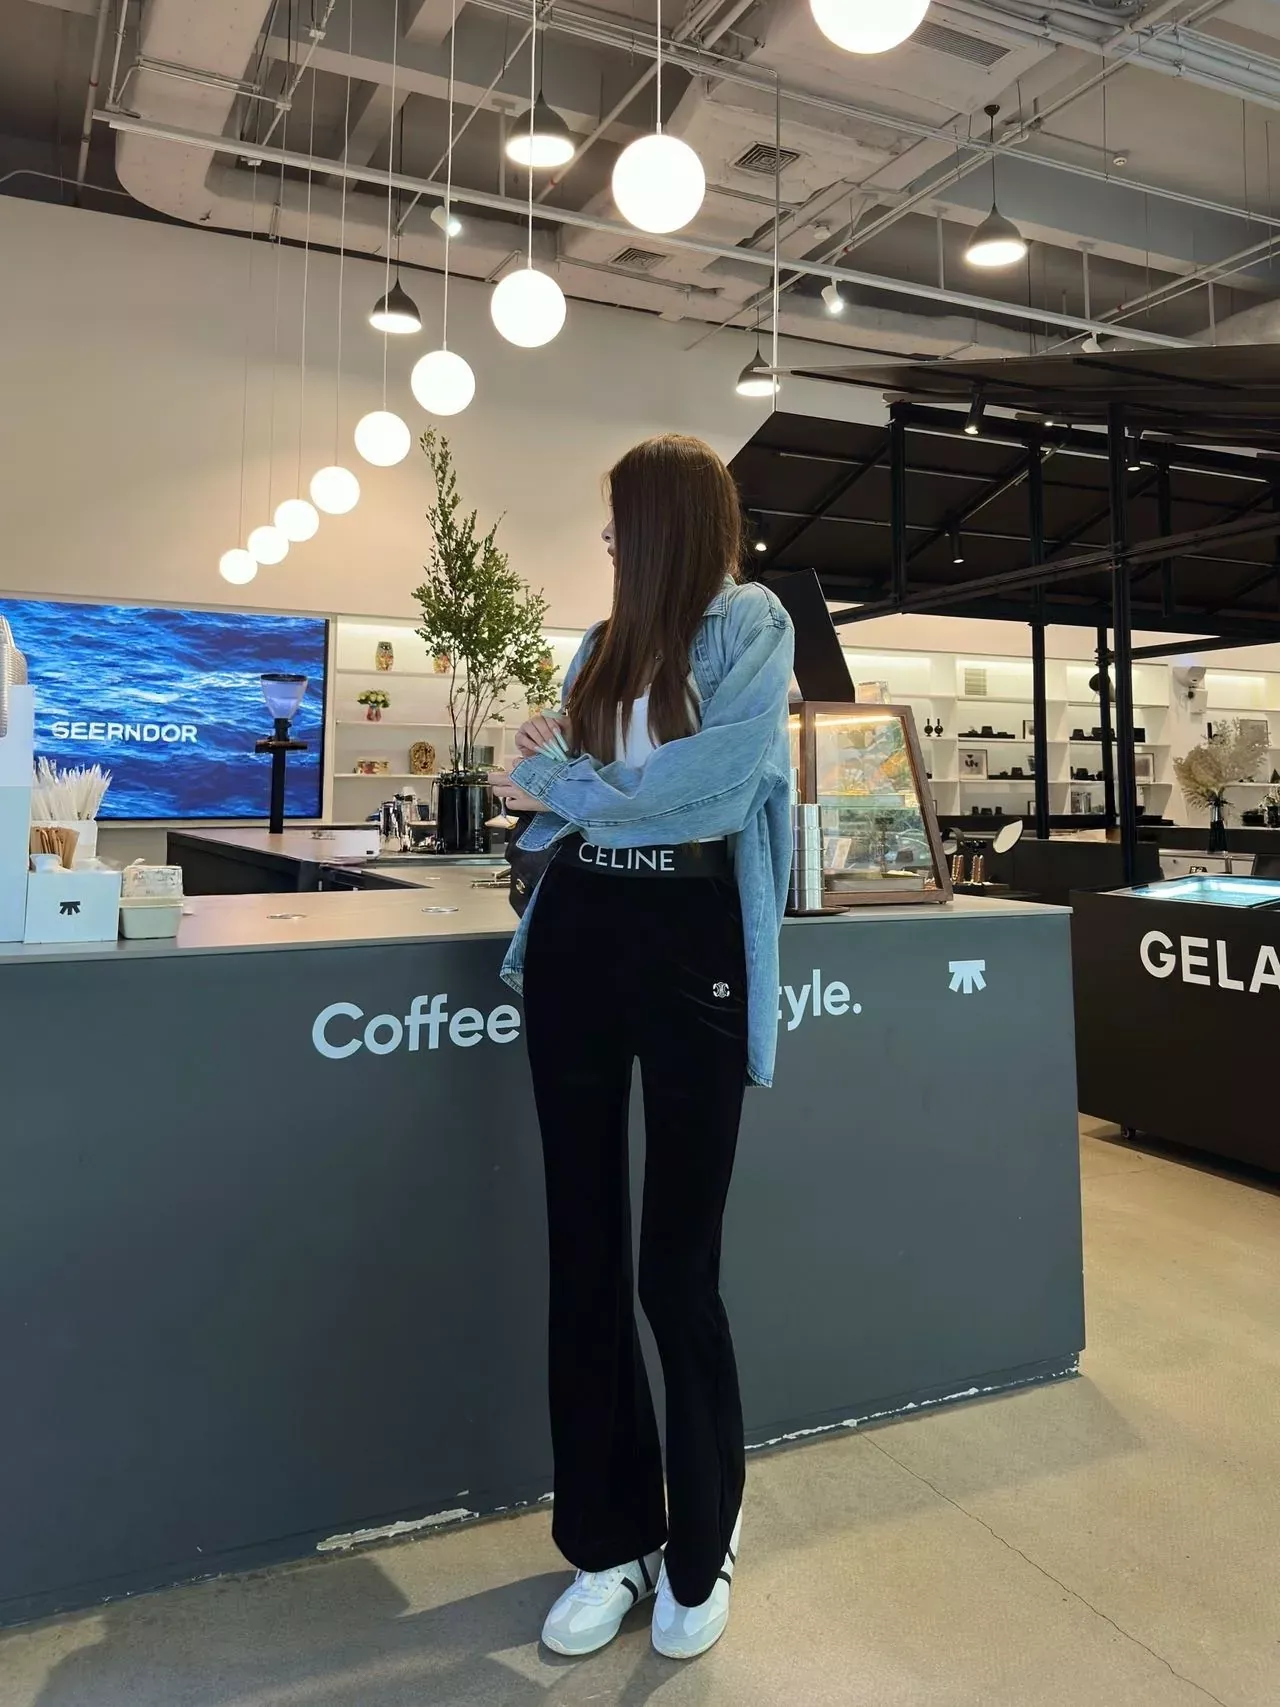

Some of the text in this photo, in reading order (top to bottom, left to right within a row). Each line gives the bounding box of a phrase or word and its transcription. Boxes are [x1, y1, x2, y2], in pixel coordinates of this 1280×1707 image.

[578, 842, 675, 871] CELINE
[1140, 930, 1280, 993] GELA
[312, 993, 521, 1059] Coffee
